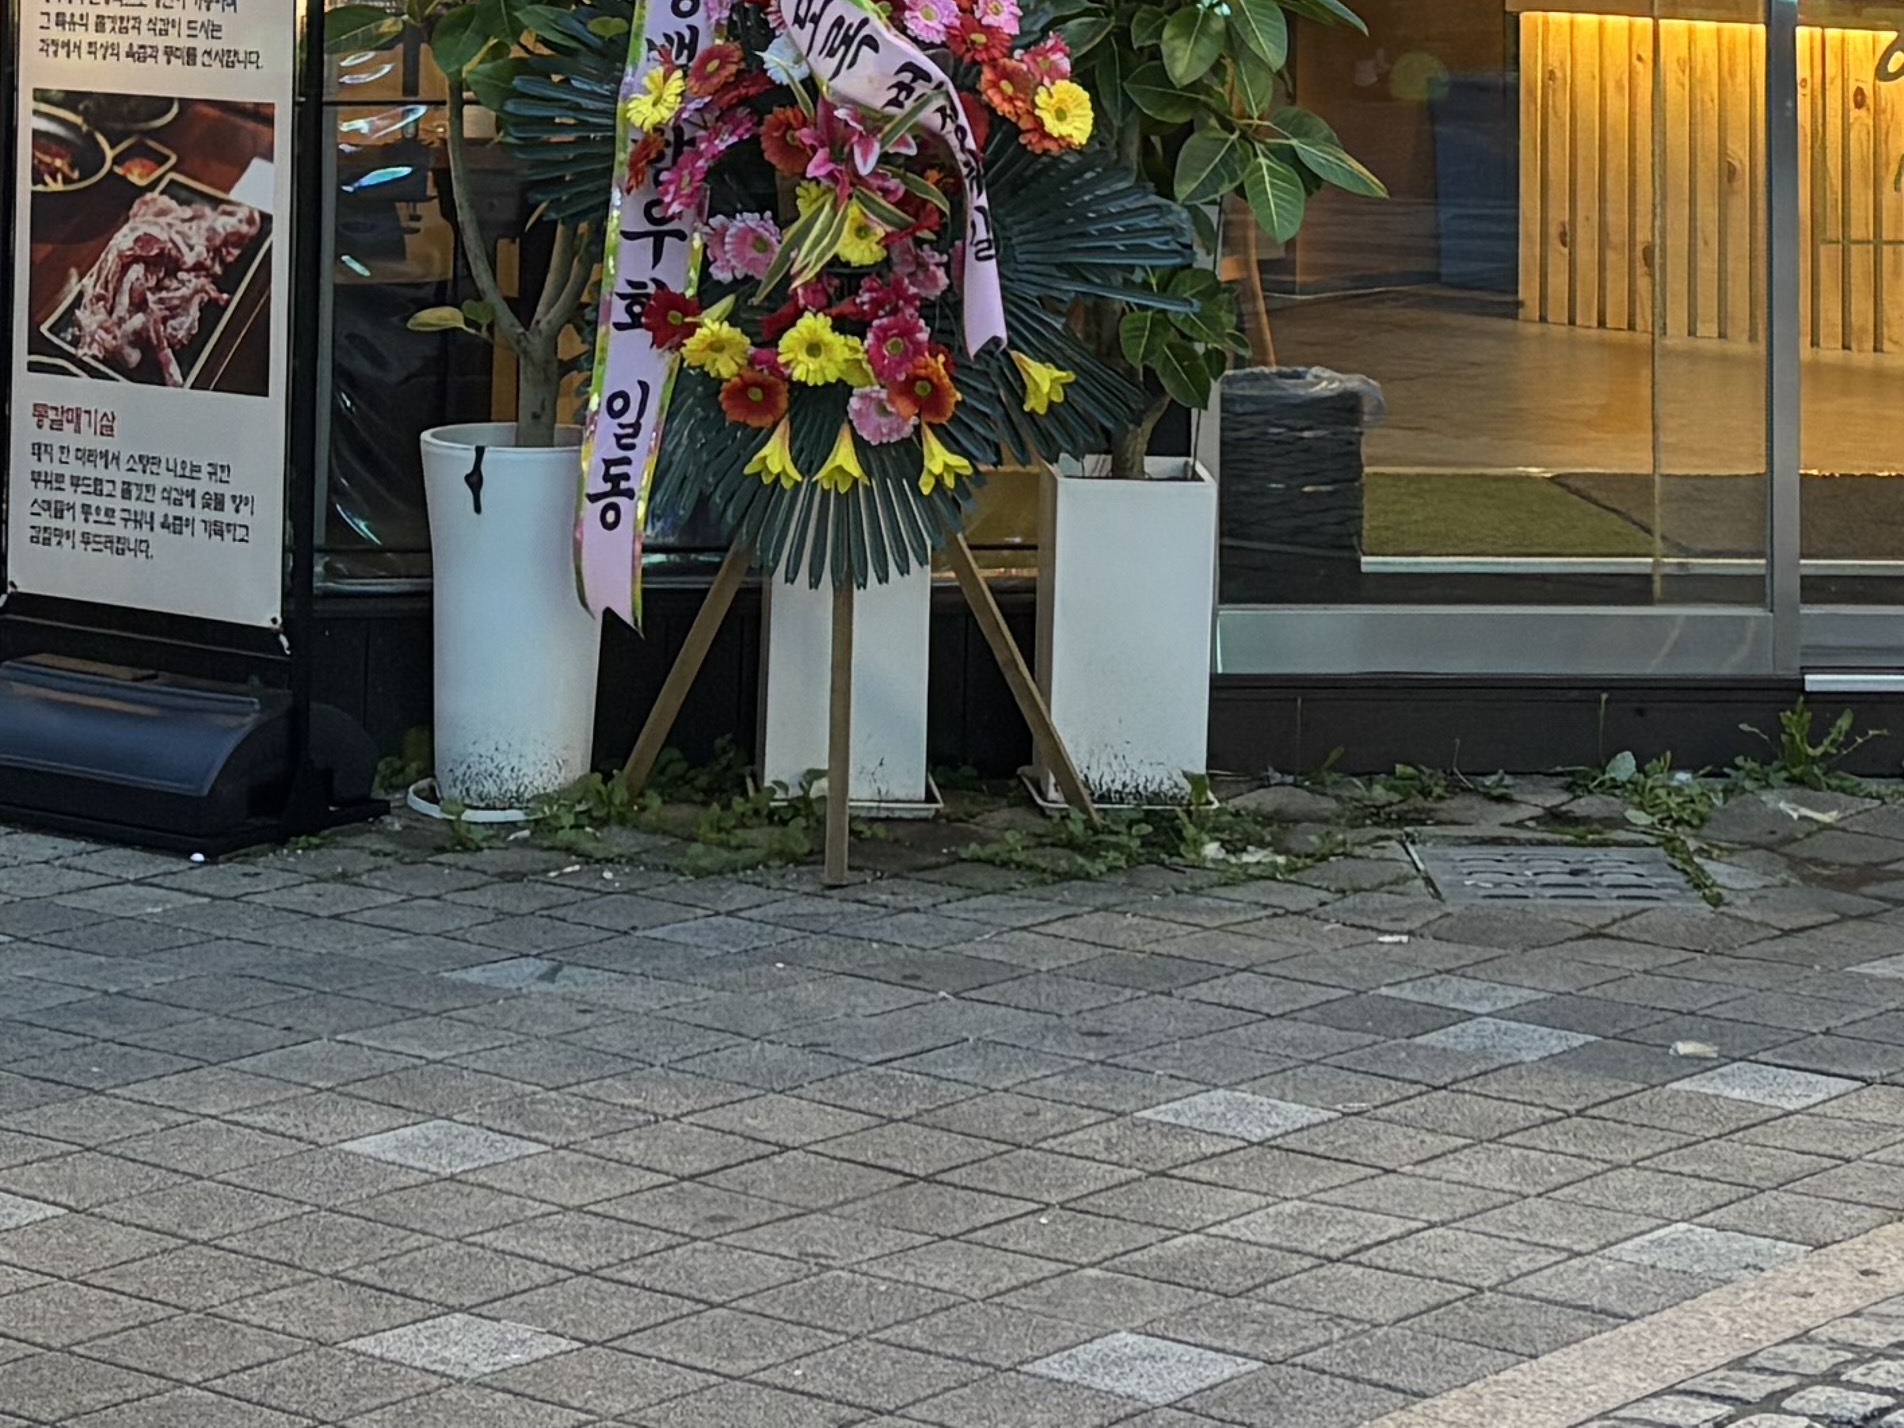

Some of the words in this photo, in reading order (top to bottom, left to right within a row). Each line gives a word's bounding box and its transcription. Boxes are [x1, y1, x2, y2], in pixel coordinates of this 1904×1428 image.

[39, 10, 51, 31] 그
[146, 16, 182, 39] 식감이
[186, 18, 223, 41] 드시는
[31, 402, 116, 439] 통갈매기살
[30, 441, 54, 464] 돼지
[58, 444, 71, 465] 한
[165, 456, 203, 481] 나오는
[586, 379, 650, 531] 일동
[30, 469, 66, 492] 부위로
[69, 473, 117, 499] 부드럽고
